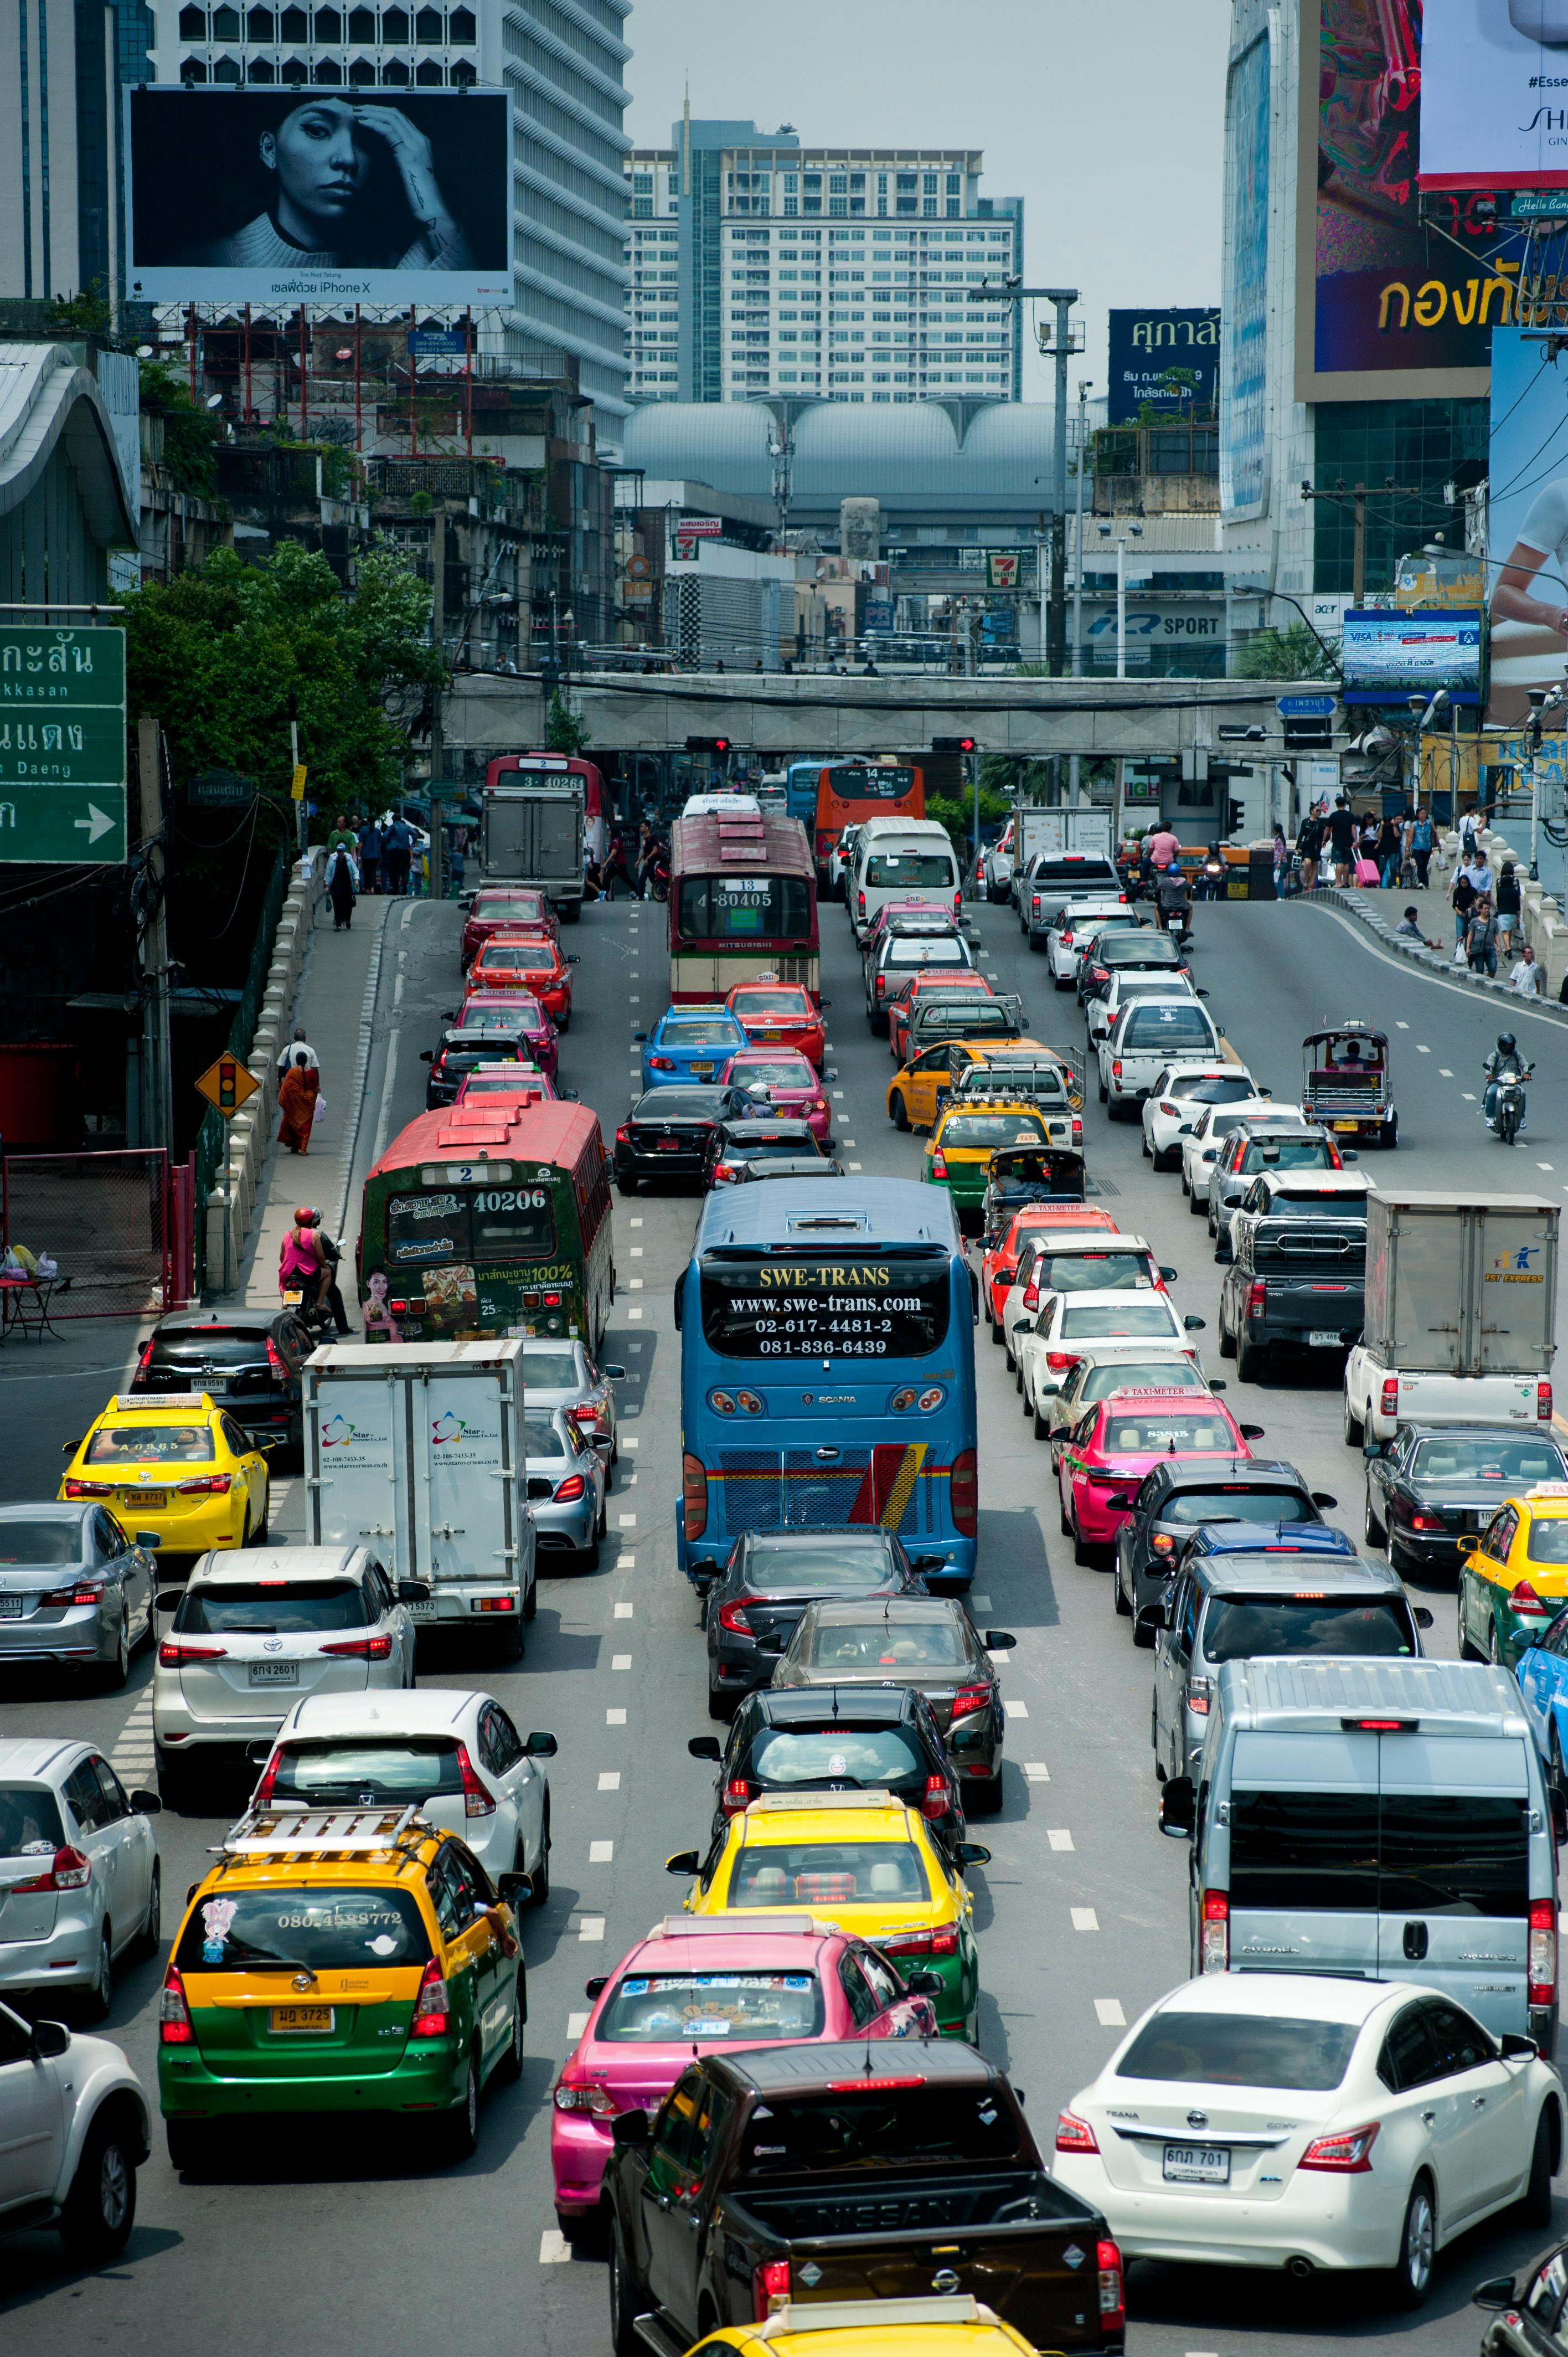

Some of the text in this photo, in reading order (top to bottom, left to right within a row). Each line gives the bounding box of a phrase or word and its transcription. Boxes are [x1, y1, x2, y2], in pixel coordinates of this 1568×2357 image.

[1518, 107, 1568, 131] SH
[1519, 198, 1546, 213] Hello
[321, 282, 360, 294] iPhone
[362, 282, 370, 293] X
[1123, 370, 1138, 381] ริม
[1195, 370, 1202, 380] 9
[865, 607, 890, 620] PR
[1315, 605, 1337, 614] acer
[1164, 617, 1219, 635] SPORT
[1351, 632, 1371, 641] VISA
[1295, 696, 1325, 708] เพชรบุรี
[18, 761, 70, 778] Daeng
[865, 768, 878, 778] 14
[740, 881, 754, 891] 13
[461, 1167, 472, 1181] 2
[473, 1190, 545, 1212] 40206
[532, 1264, 572, 1282] 100%
[760, 1267, 889, 1286] SWE-TRANS
[1484, 1274, 1544, 1283] TST EXPRESS
[731, 1295, 921, 1312] www.swe-trans.com
[756, 1320, 892, 1332] 02-617-4481-2
[760, 1341, 886, 1354] 081-836-6439
[274, 1665, 295, 1674] 2601
[1458, 1953, 1517, 1961] JUMPER
[301, 2009, 329, 2020] 3725
[1106, 2111, 1139, 2119] TEANA
[1200, 2152, 1221, 2166] 701
[818, 2200, 951, 2229] NISSAN
